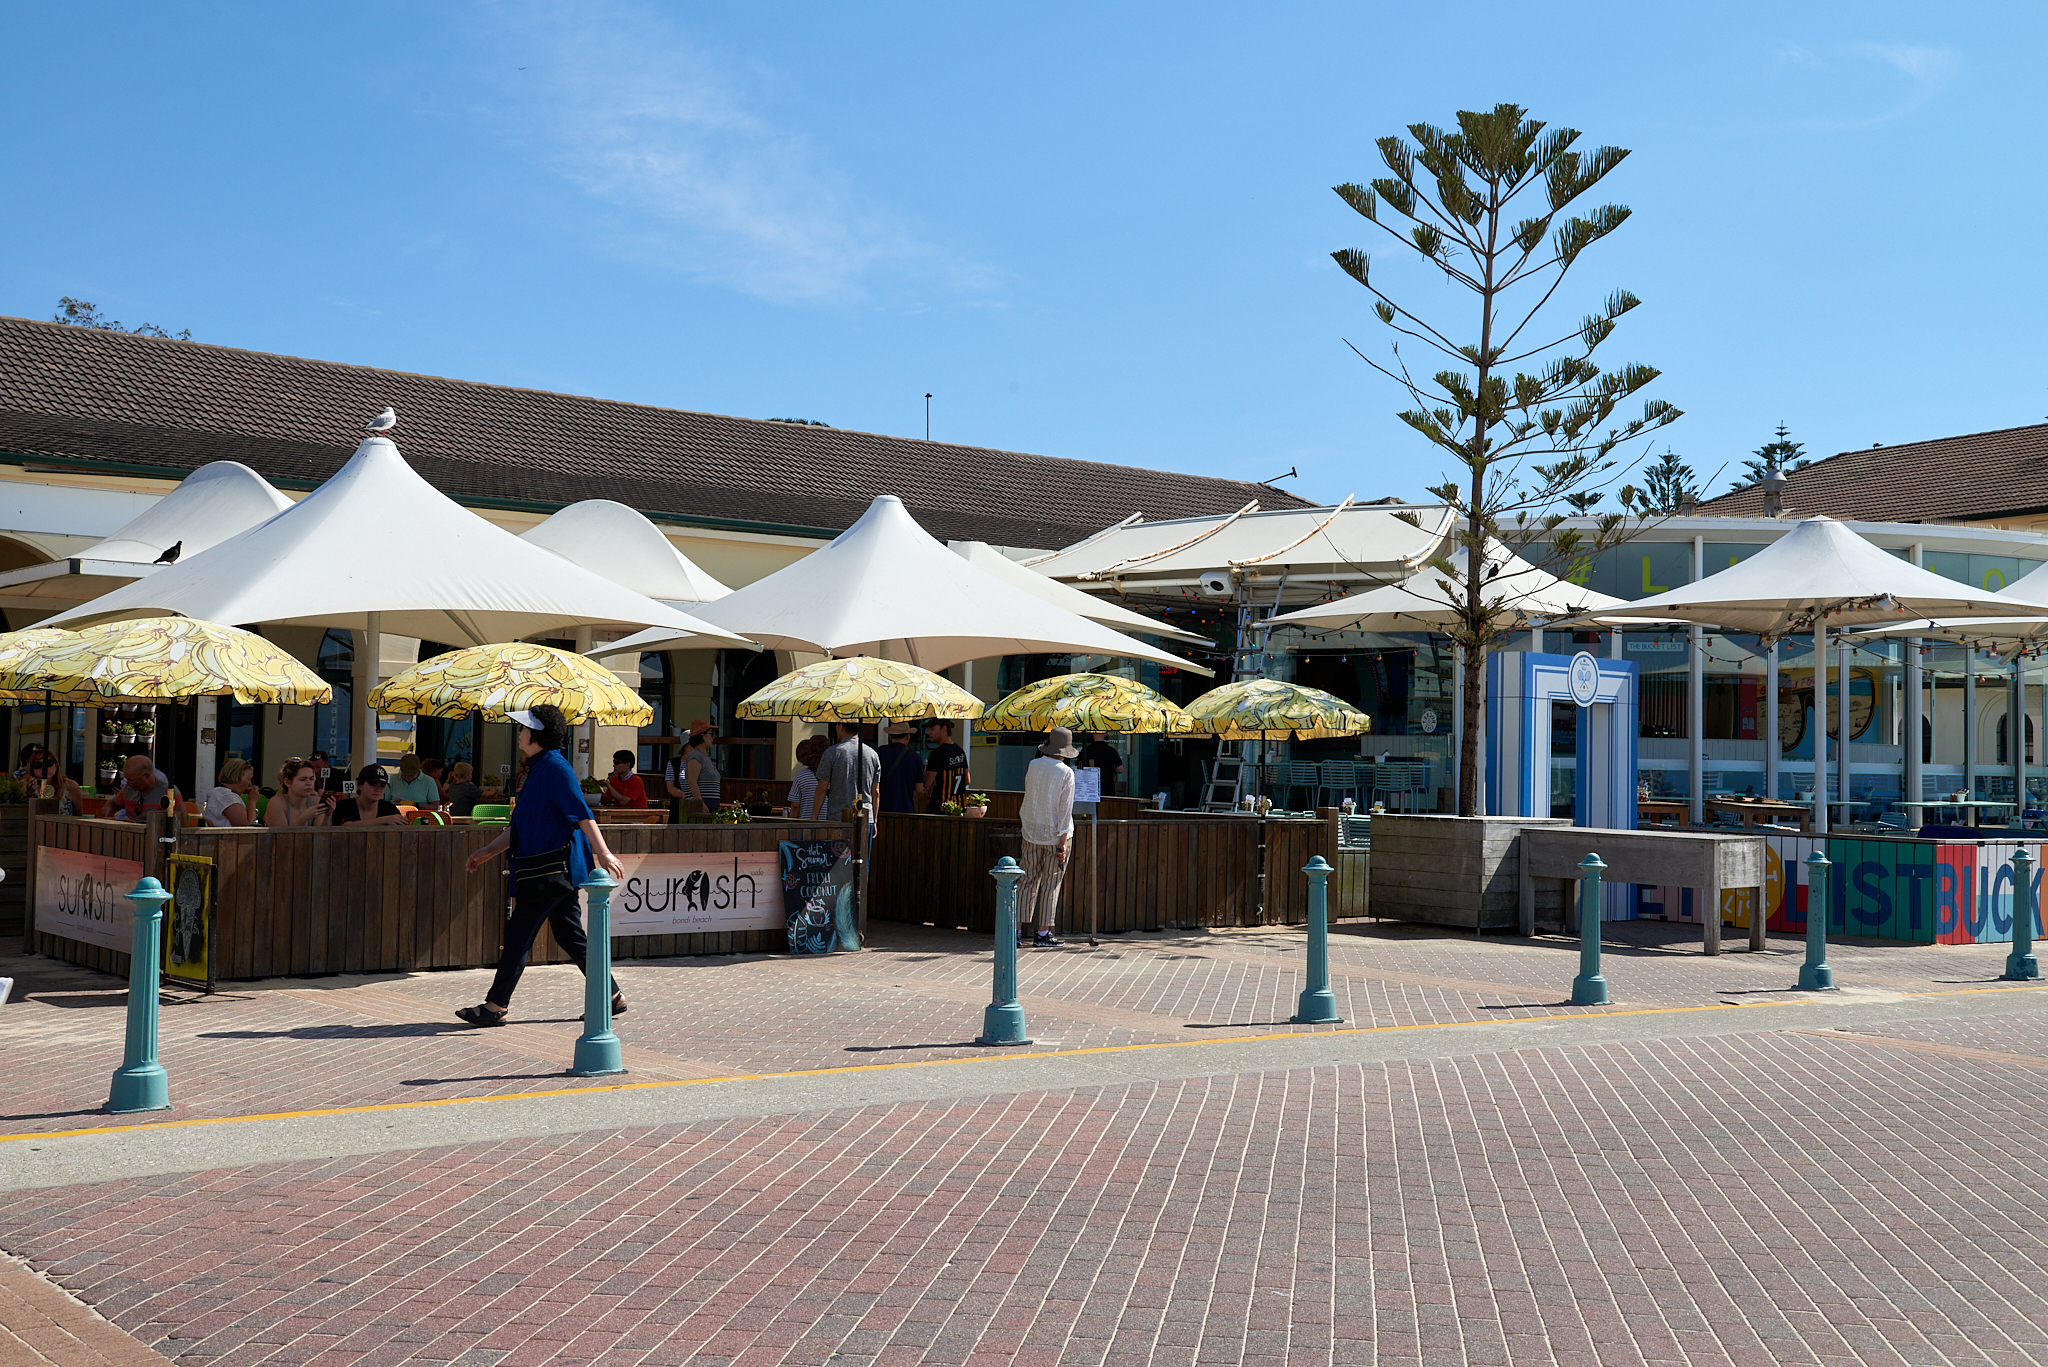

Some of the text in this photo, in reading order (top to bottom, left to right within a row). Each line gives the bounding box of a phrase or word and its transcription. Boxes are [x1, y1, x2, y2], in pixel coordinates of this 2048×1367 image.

[502, 765, 509, 773] 65
[344, 782, 354, 792] 99
[953, 775, 962, 795] 7
[800, 885, 837, 898] COCONUT
[672, 914, 712, 924] bondi beach
